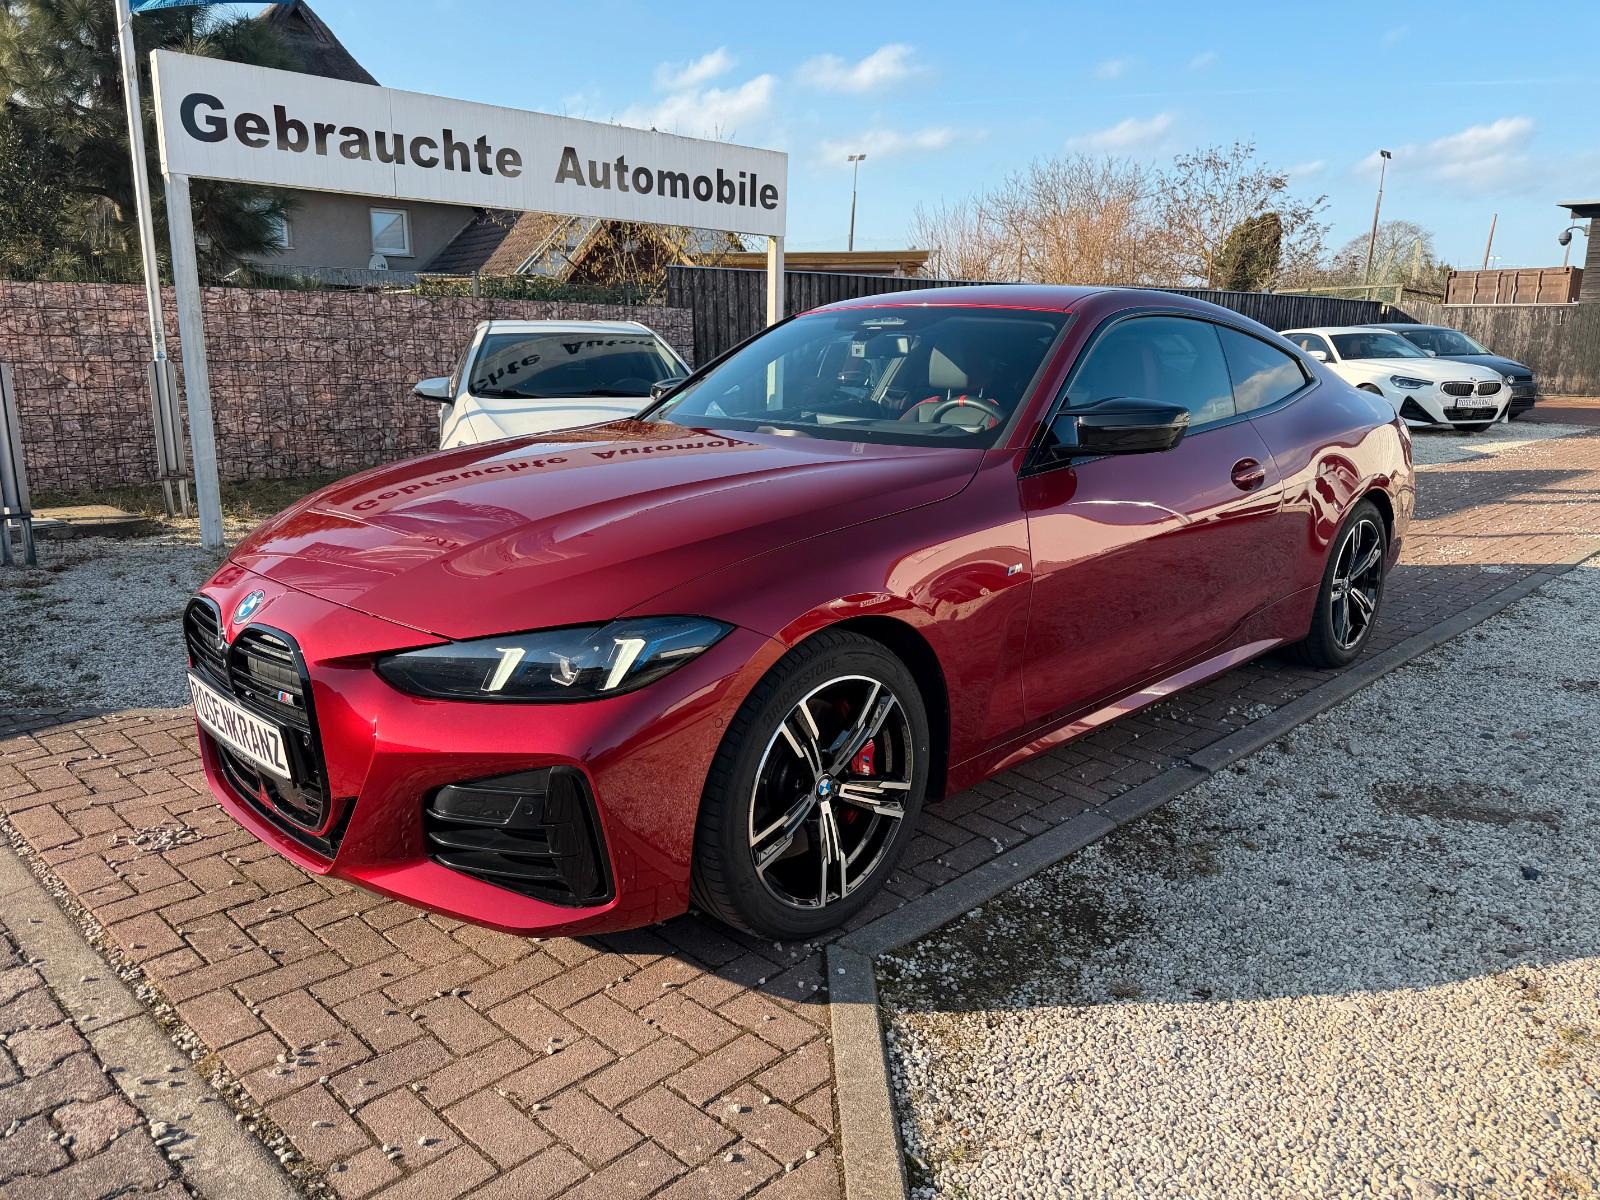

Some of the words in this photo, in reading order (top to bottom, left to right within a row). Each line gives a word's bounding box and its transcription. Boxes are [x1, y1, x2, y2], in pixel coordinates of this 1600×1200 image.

[180, 92, 523, 178] Gebrauchte
[555, 146, 779, 210] Automobile
[190, 680, 286, 770] ROSENKRANZ
